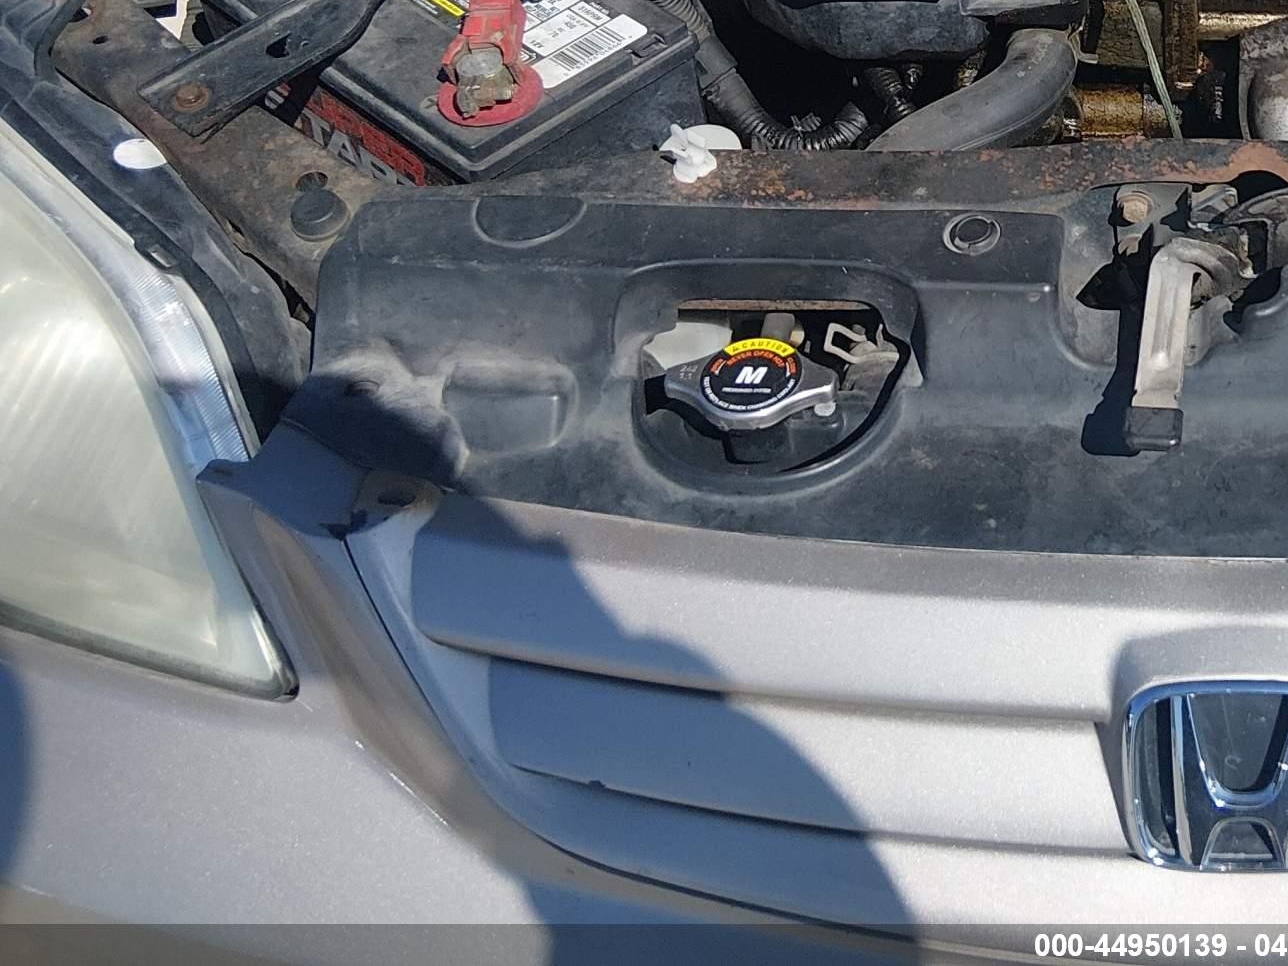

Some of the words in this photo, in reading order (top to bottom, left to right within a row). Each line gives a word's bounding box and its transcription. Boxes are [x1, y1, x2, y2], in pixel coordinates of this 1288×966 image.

[741, 339, 788, 354] CAUTION
[727, 350, 752, 367] NEVER
[735, 366, 768, 384] M
